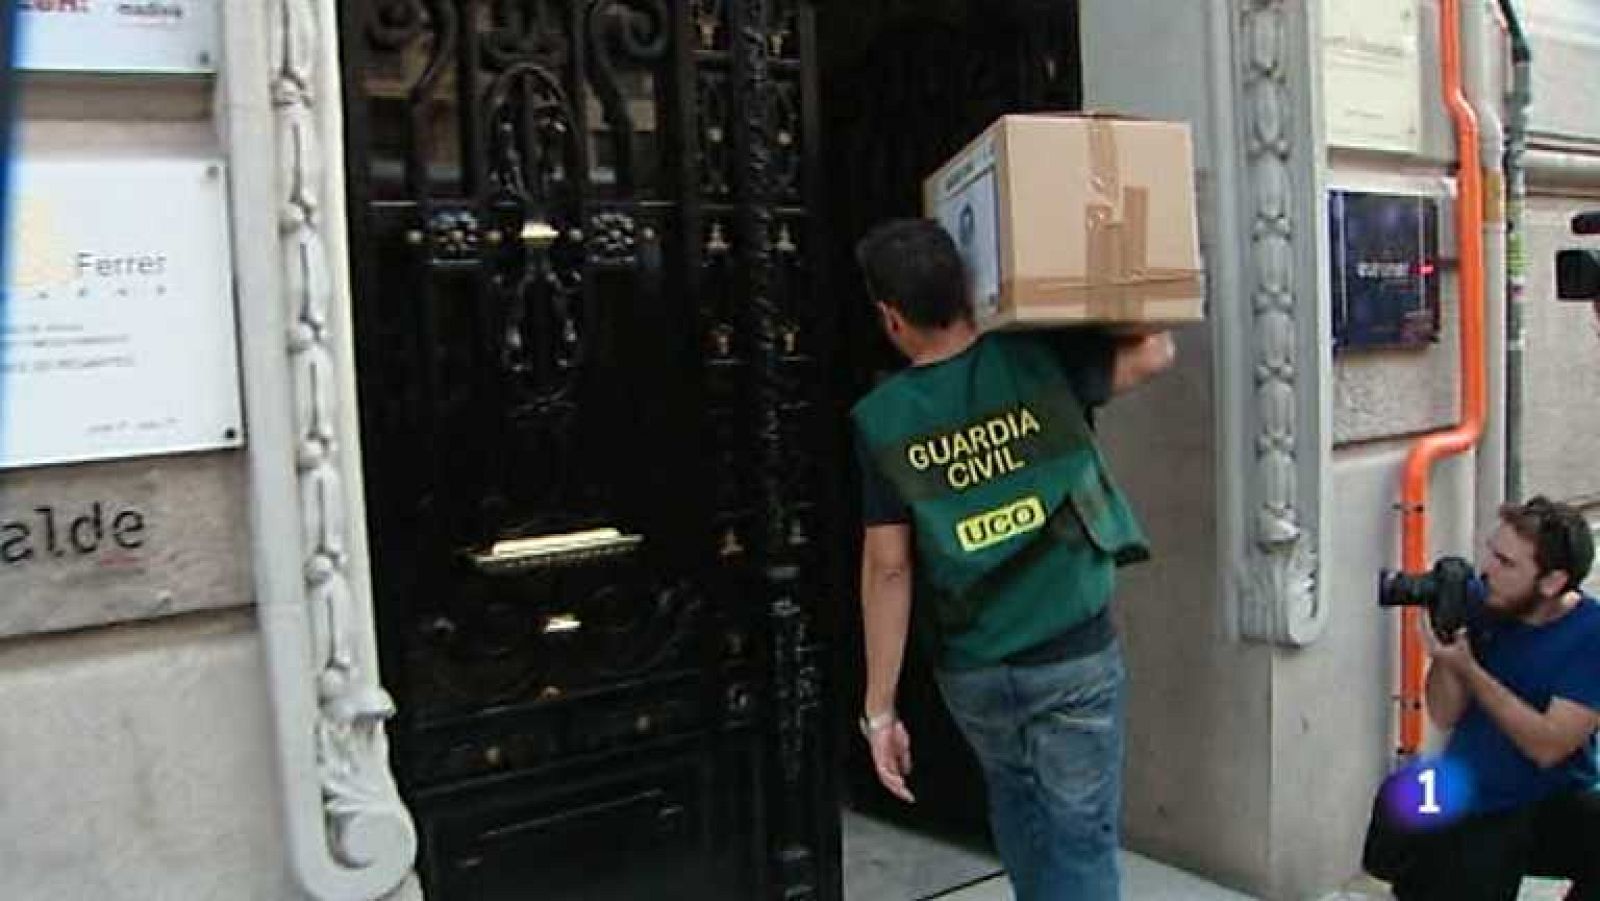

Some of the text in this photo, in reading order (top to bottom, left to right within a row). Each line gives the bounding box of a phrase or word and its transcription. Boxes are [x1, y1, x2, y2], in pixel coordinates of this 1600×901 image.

[908, 407, 1041, 471] GUARDIA
[948, 446, 1026, 490] CIVIL
[963, 503, 1037, 544] UCO
